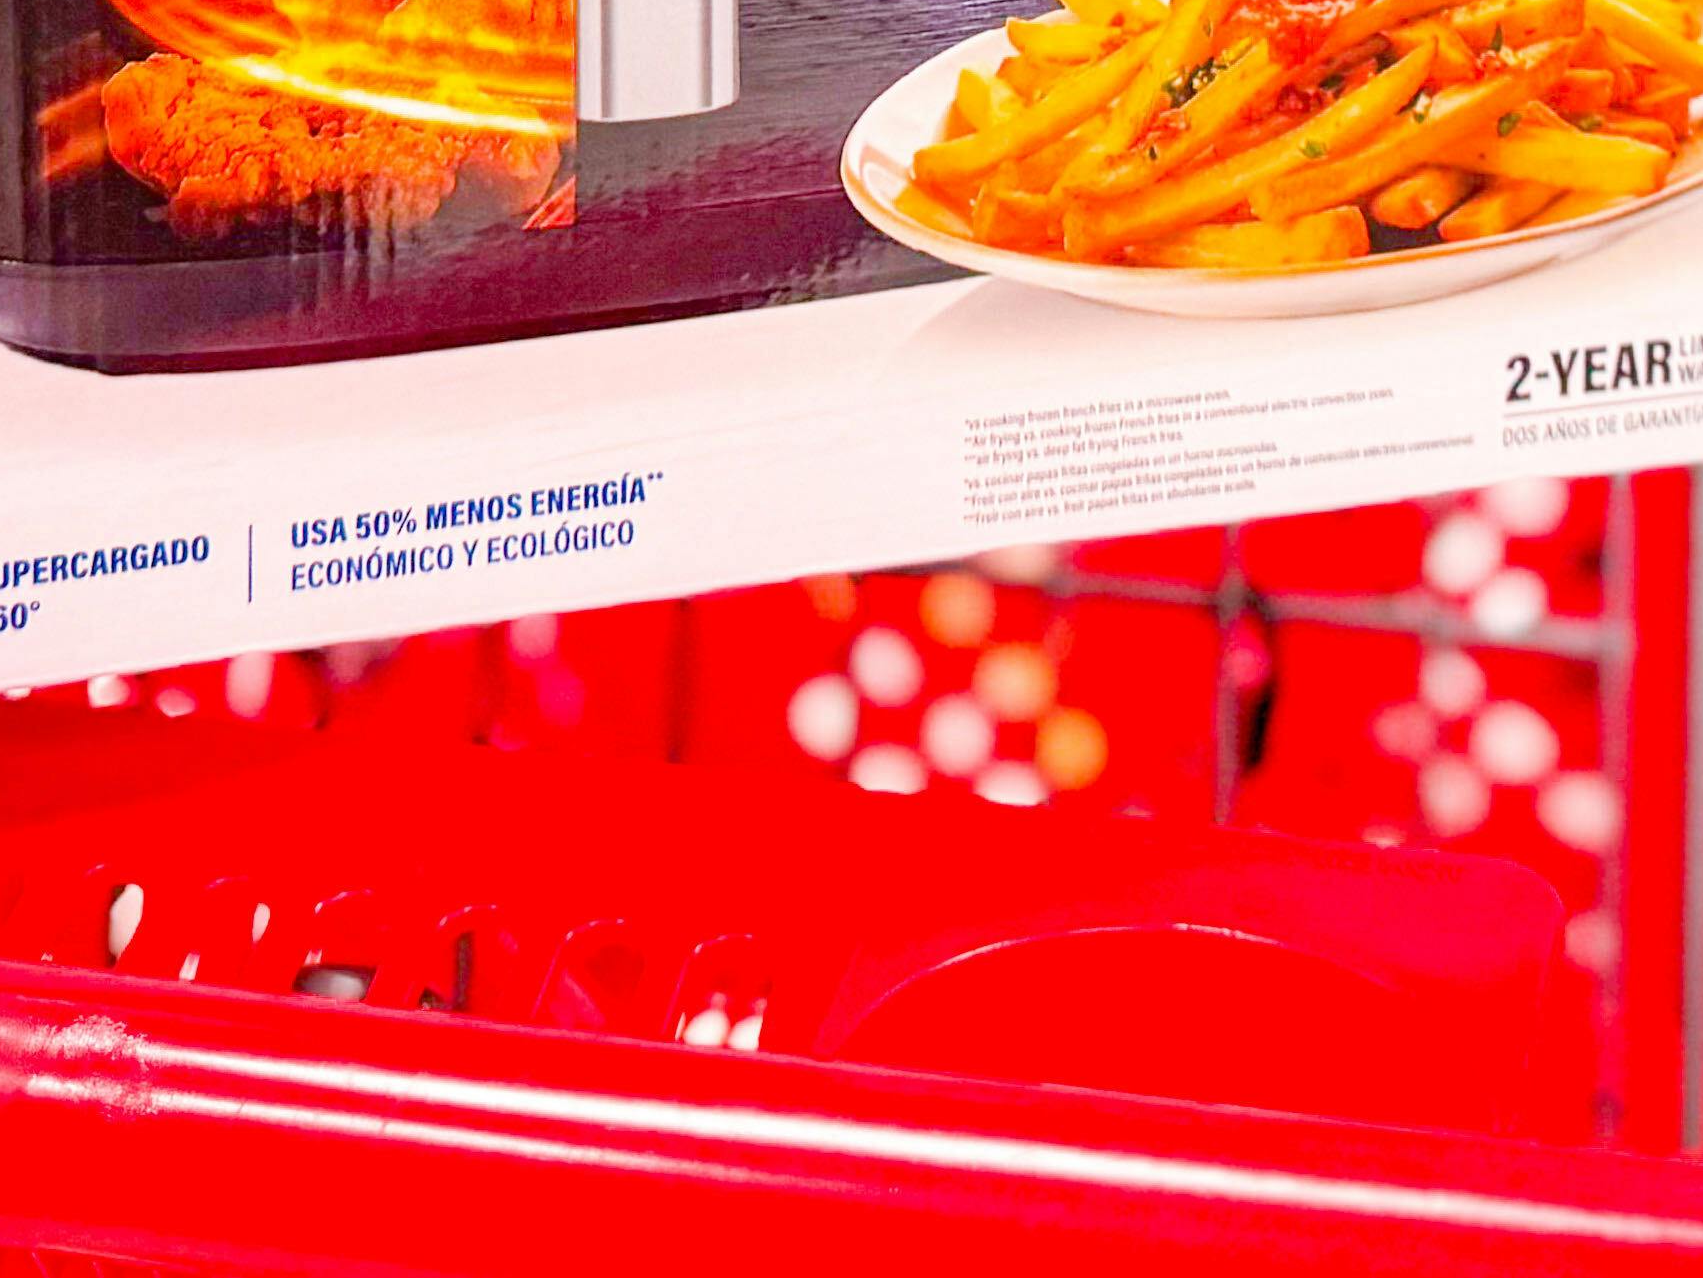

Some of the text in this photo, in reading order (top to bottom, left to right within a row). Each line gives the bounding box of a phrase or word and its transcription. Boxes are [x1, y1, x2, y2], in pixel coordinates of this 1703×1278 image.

[1506, 339, 1672, 403] 2-YEAR
[1502, 426, 1538, 448] DOS
[1544, 416, 1591, 443] AÑOS
[1597, 413, 1618, 435] DE
[290, 517, 347, 549] USA
[356, 507, 417, 540] 50%
[426, 493, 523, 530] MENOS
[291, 519, 634, 590] ECONÓMICO Y ECOLÓGICO
